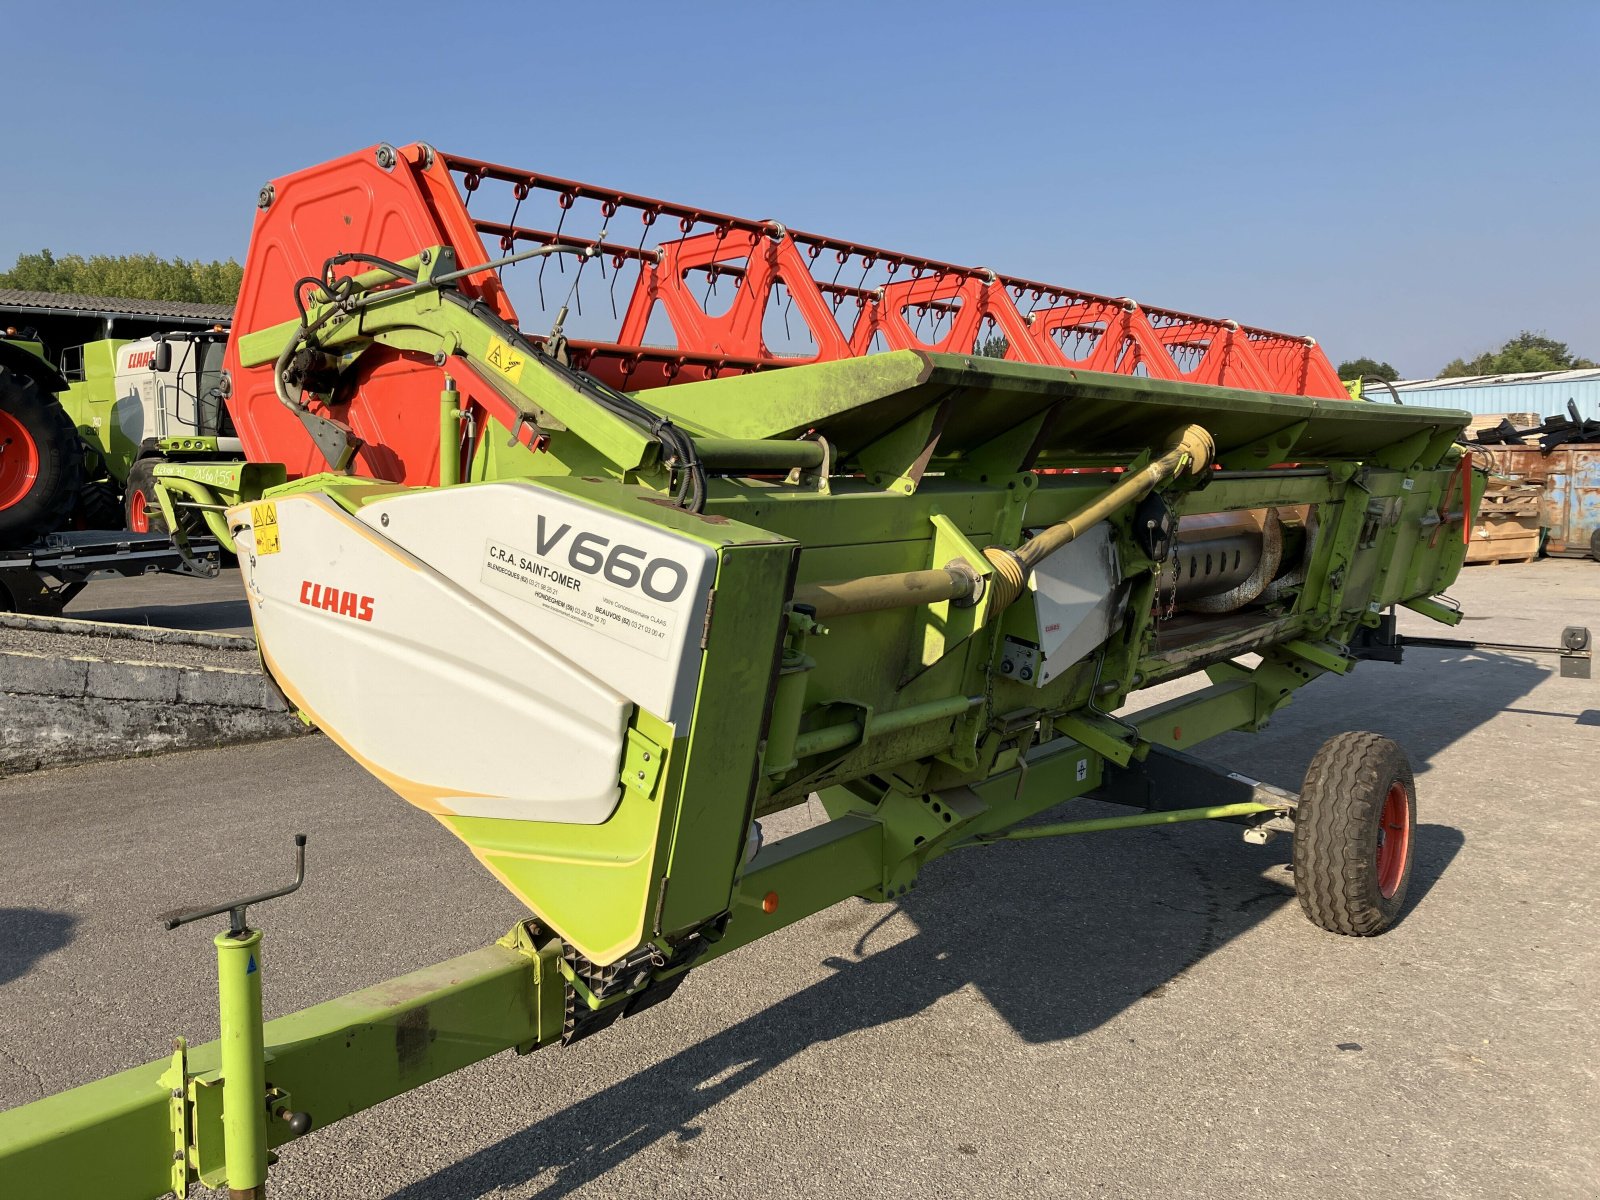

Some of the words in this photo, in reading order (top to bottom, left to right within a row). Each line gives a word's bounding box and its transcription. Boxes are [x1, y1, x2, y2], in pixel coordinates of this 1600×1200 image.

[487, 561, 520, 580] BLENDECQUES
[489, 546, 517, 566] C.R.A.
[519, 557, 582, 592] SAINT-OMER
[299, 580, 375, 622] CLAAS
[534, 590, 566, 609] HONDEGHEM
[594, 606, 621, 622] BEAUVOIS
[650, 615, 667, 627] CLAAS
